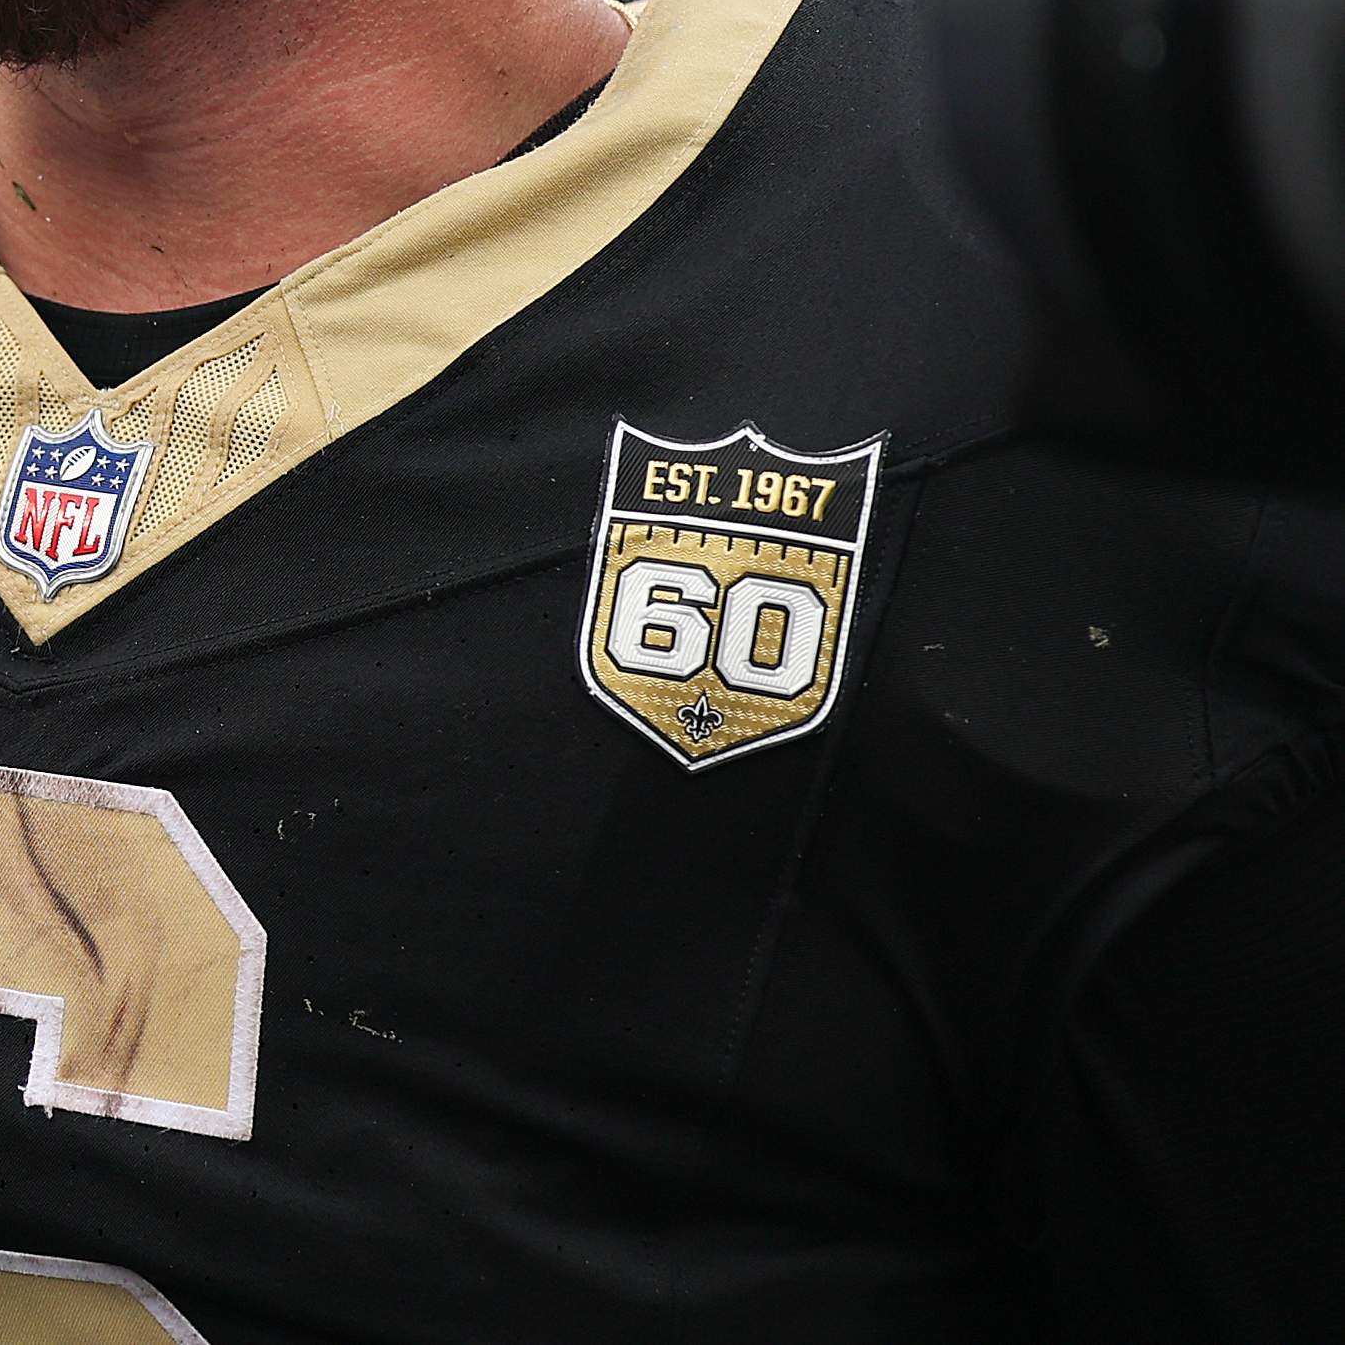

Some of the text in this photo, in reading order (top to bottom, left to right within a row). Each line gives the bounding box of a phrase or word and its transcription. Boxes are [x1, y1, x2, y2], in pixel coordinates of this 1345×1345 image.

[14, 486, 102, 562] NFL
[643, 460, 837, 522] EST. 1967
[606, 558, 827, 699] 60
